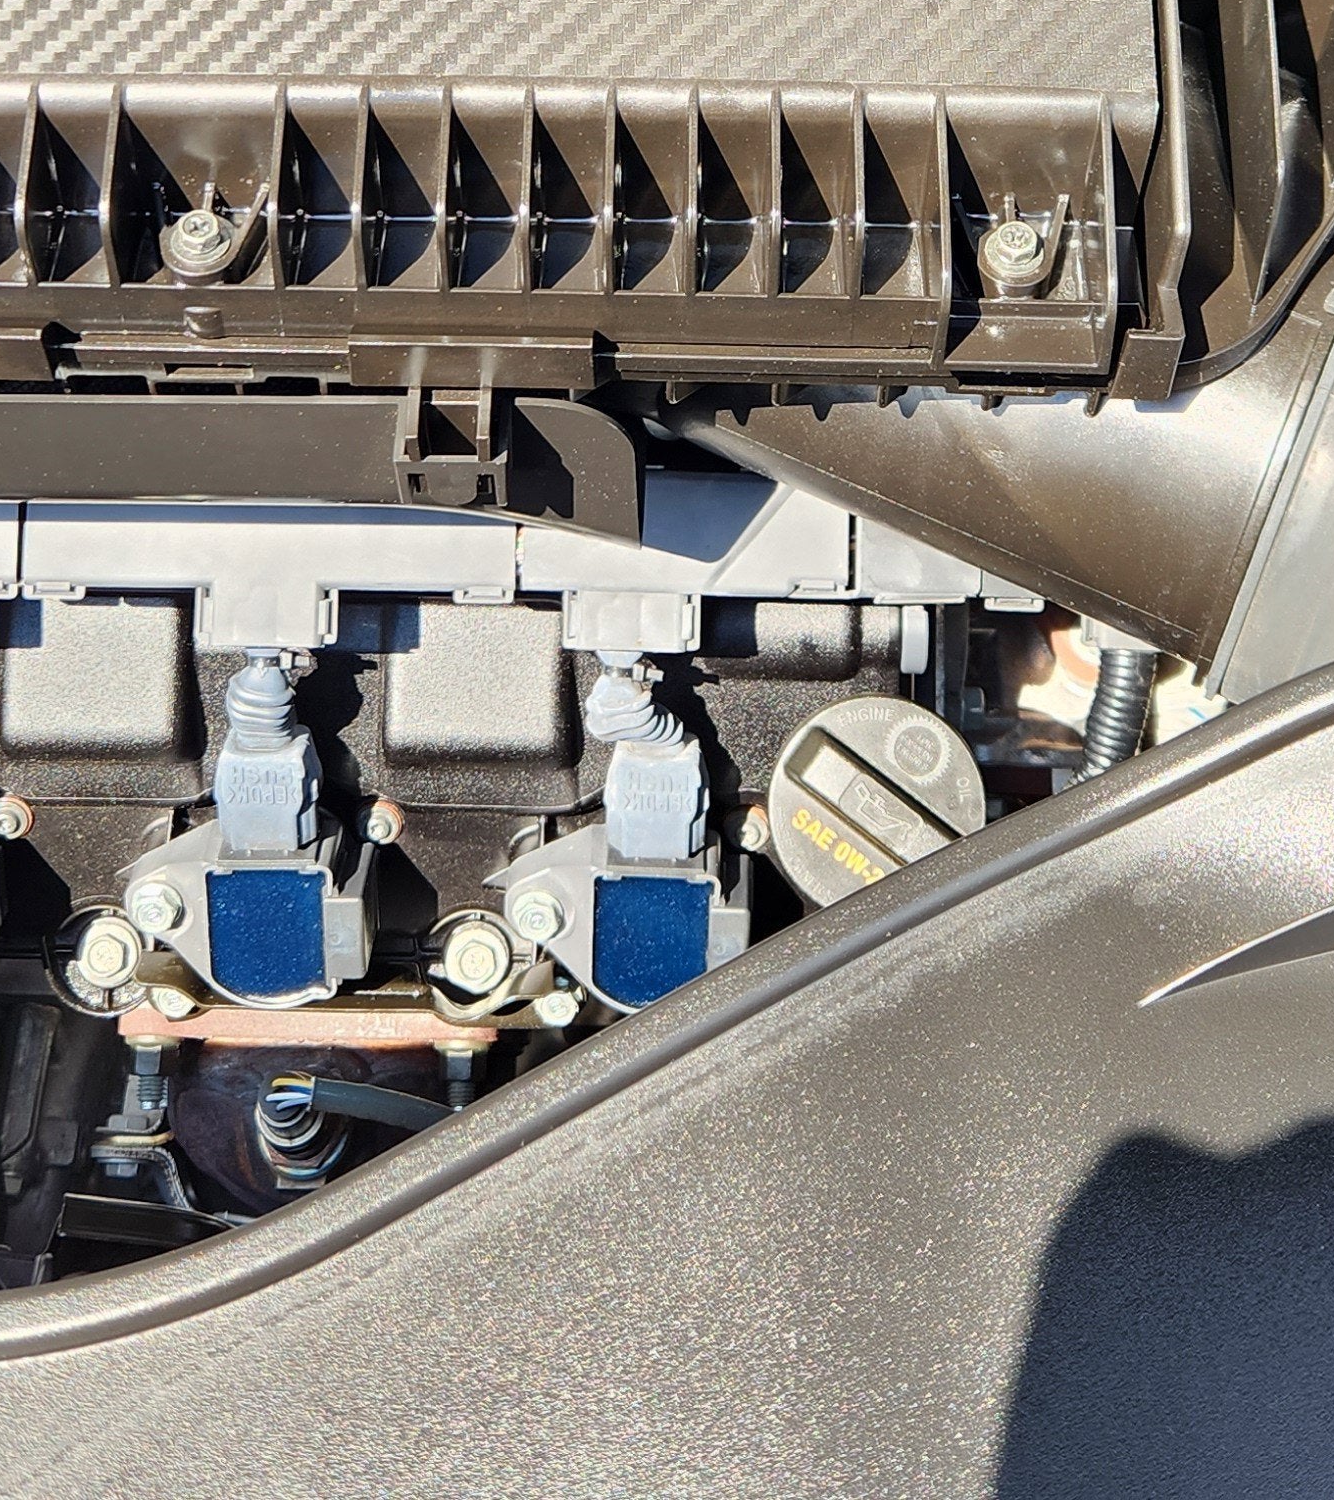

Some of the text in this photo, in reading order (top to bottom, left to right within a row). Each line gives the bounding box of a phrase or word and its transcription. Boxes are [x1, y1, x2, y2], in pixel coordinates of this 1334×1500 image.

[836, 706, 896, 728] ENGINE
[232, 767, 294, 784] PUSH
[955, 775, 971, 804] OIL
[792, 808, 886, 886] SAE 0W-2
